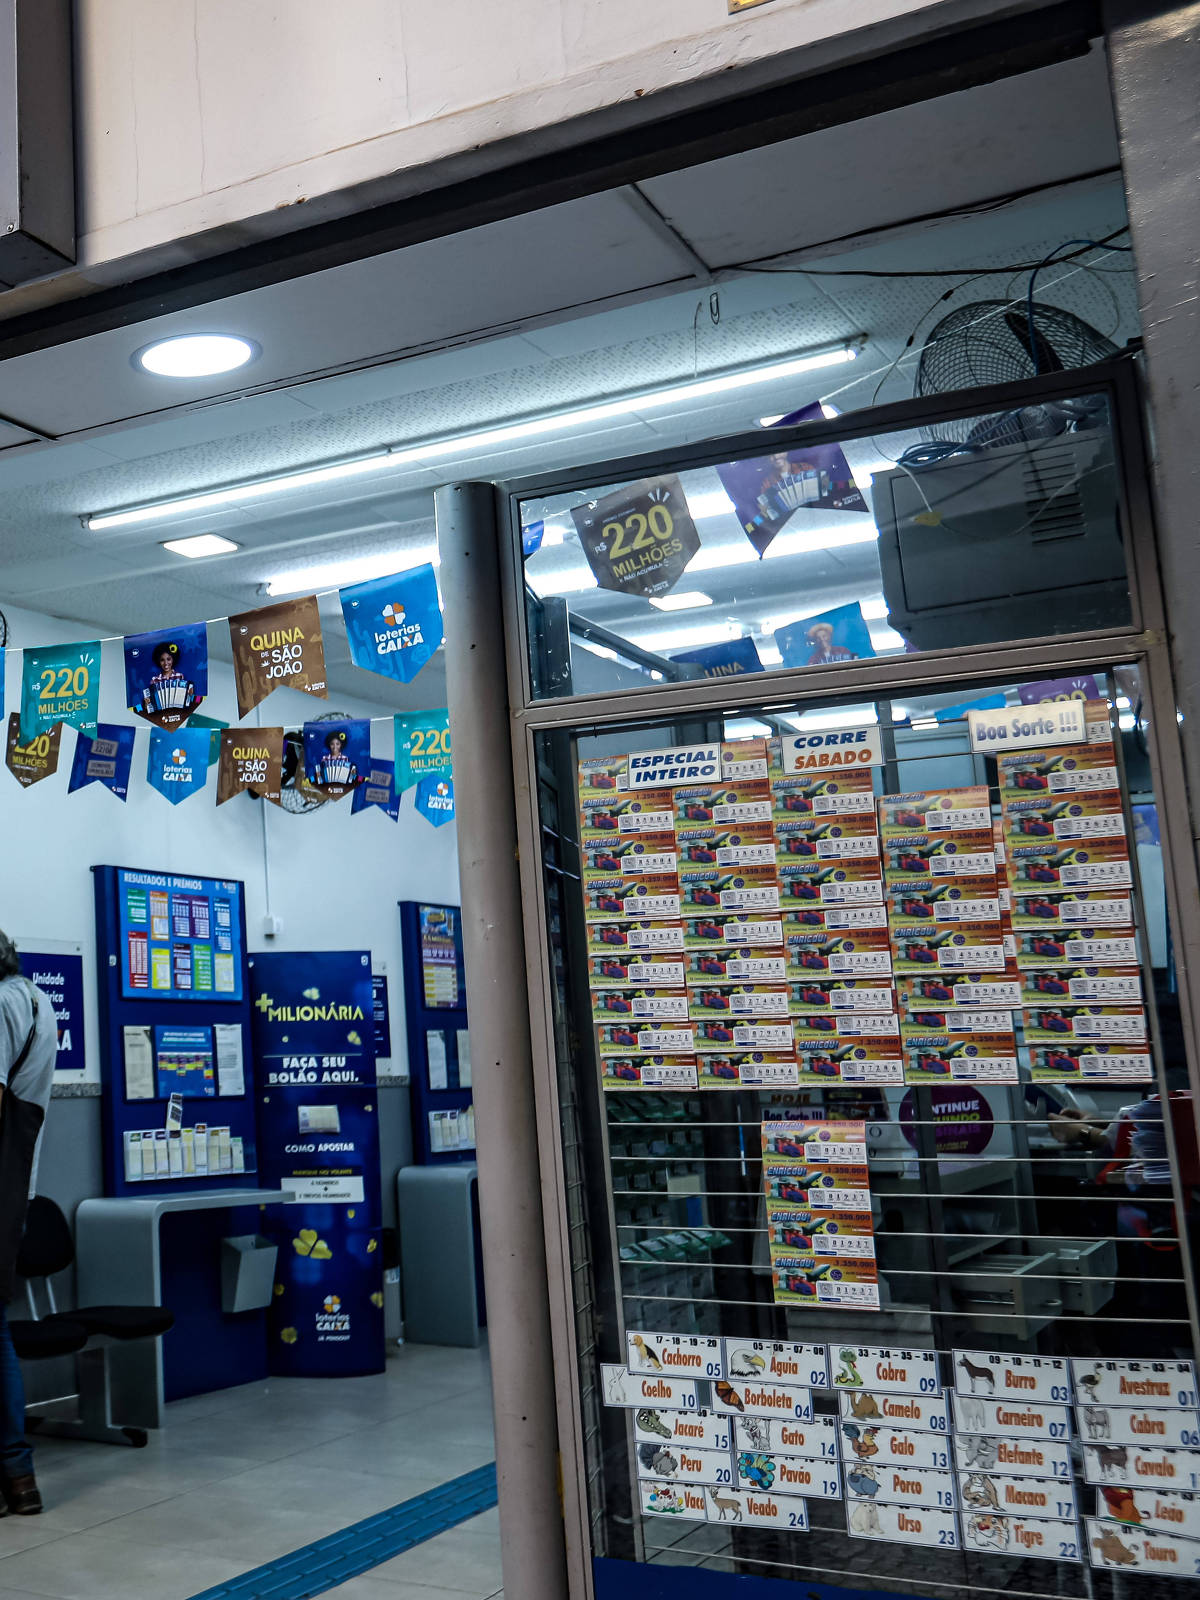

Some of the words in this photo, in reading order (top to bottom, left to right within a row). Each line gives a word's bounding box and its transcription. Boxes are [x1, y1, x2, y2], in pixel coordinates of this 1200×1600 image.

[602, 505, 673, 560] 220
[613, 539, 682, 577] MILHÕES
[250, 627, 304, 651] QUINA
[374, 623, 421, 643] loterias
[377, 633, 424, 655] CAIXA
[271, 645, 302, 663] SÃO
[266, 660, 303, 679] JOÃO
[40, 667, 88, 699] 220
[39, 697, 88, 714] MILHÕES
[976, 721, 1007, 742] Boa
[1012, 719, 1054, 738] Sorte
[1059, 712, 1078, 732] !!!
[794, 730, 867, 749] CORRE
[232, 748, 270, 759] QUINA
[410, 755, 452, 769] MILHÕE
[631, 751, 717, 769] ESPECIAL
[794, 749, 872, 770] SÁBADO
[163, 764, 192, 773] loterias
[245, 760, 267, 771] SÃO
[636, 764, 715, 783] INTEIRO
[163, 773, 192, 782] CAIXA
[240, 772, 265, 783] JOÃO
[124, 873, 166, 886] RESULTADOS
[173, 878, 202, 890] PRÊMIOS
[33, 972, 64, 985] Unidade
[283, 1057, 317, 1071] FAÇA
[322, 1056, 346, 1067] SEU
[269, 1069, 317, 1083] BOLÃO
[322, 1071, 358, 1082] AQUI.
[285, 1144, 315, 1153] COMO
[318, 1142, 354, 1152] APOSTAR
[316, 1322, 350, 1330] CAIXA
[662, 1349, 701, 1366] Cachorro
[770, 1352, 798, 1377] Águia
[706, 1363, 720, 1376] 05
[876, 1362, 906, 1382] Cobra
[810, 1372, 825, 1385] 02
[920, 1378, 935, 1392] 09
[1005, 1370, 1036, 1389] Burro
[1120, 1377, 1170, 1395] Avestruz
[642, 1380, 671, 1398] Coelho
[1051, 1387, 1068, 1400] 03
[681, 1394, 695, 1407] 10
[744, 1389, 792, 1409] Borboleta
[1178, 1391, 1194, 1405] 01
[795, 1405, 810, 1418] 04
[883, 1399, 921, 1420] Camelo
[996, 1407, 1043, 1428] Carneiro
[674, 1419, 703, 1438] Jacaré
[930, 1416, 945, 1430] 08
[1050, 1423, 1066, 1437] 07
[1130, 1414, 1165, 1434] Cabra
[714, 1435, 728, 1448] 15
[782, 1427, 804, 1446] Gato
[1181, 1431, 1199, 1445] 06
[821, 1443, 835, 1457] 14
[890, 1436, 914, 1456] Galo
[998, 1443, 1044, 1465] Elefante
[681, 1455, 702, 1472] Peru
[932, 1453, 947, 1466] 13
[1135, 1456, 1175, 1477] Cavalo
[716, 1469, 730, 1482] 20
[780, 1465, 810, 1484] Pavão
[1053, 1462, 1068, 1476] 12
[823, 1481, 837, 1494] 19
[893, 1475, 922, 1495] Porco
[937, 1492, 952, 1505] 18
[1005, 1485, 1047, 1506] Macaco
[747, 1498, 777, 1517] Veado
[1057, 1503, 1073, 1516] 17
[1155, 1500, 1184, 1523] Leão
[789, 1513, 804, 1526] 24
[898, 1513, 922, 1533] Urso
[939, 1531, 955, 1544] 23
[1014, 1524, 1043, 1548] Tigre
[1060, 1543, 1077, 1557] 22
[1143, 1541, 1177, 1562] Touro
